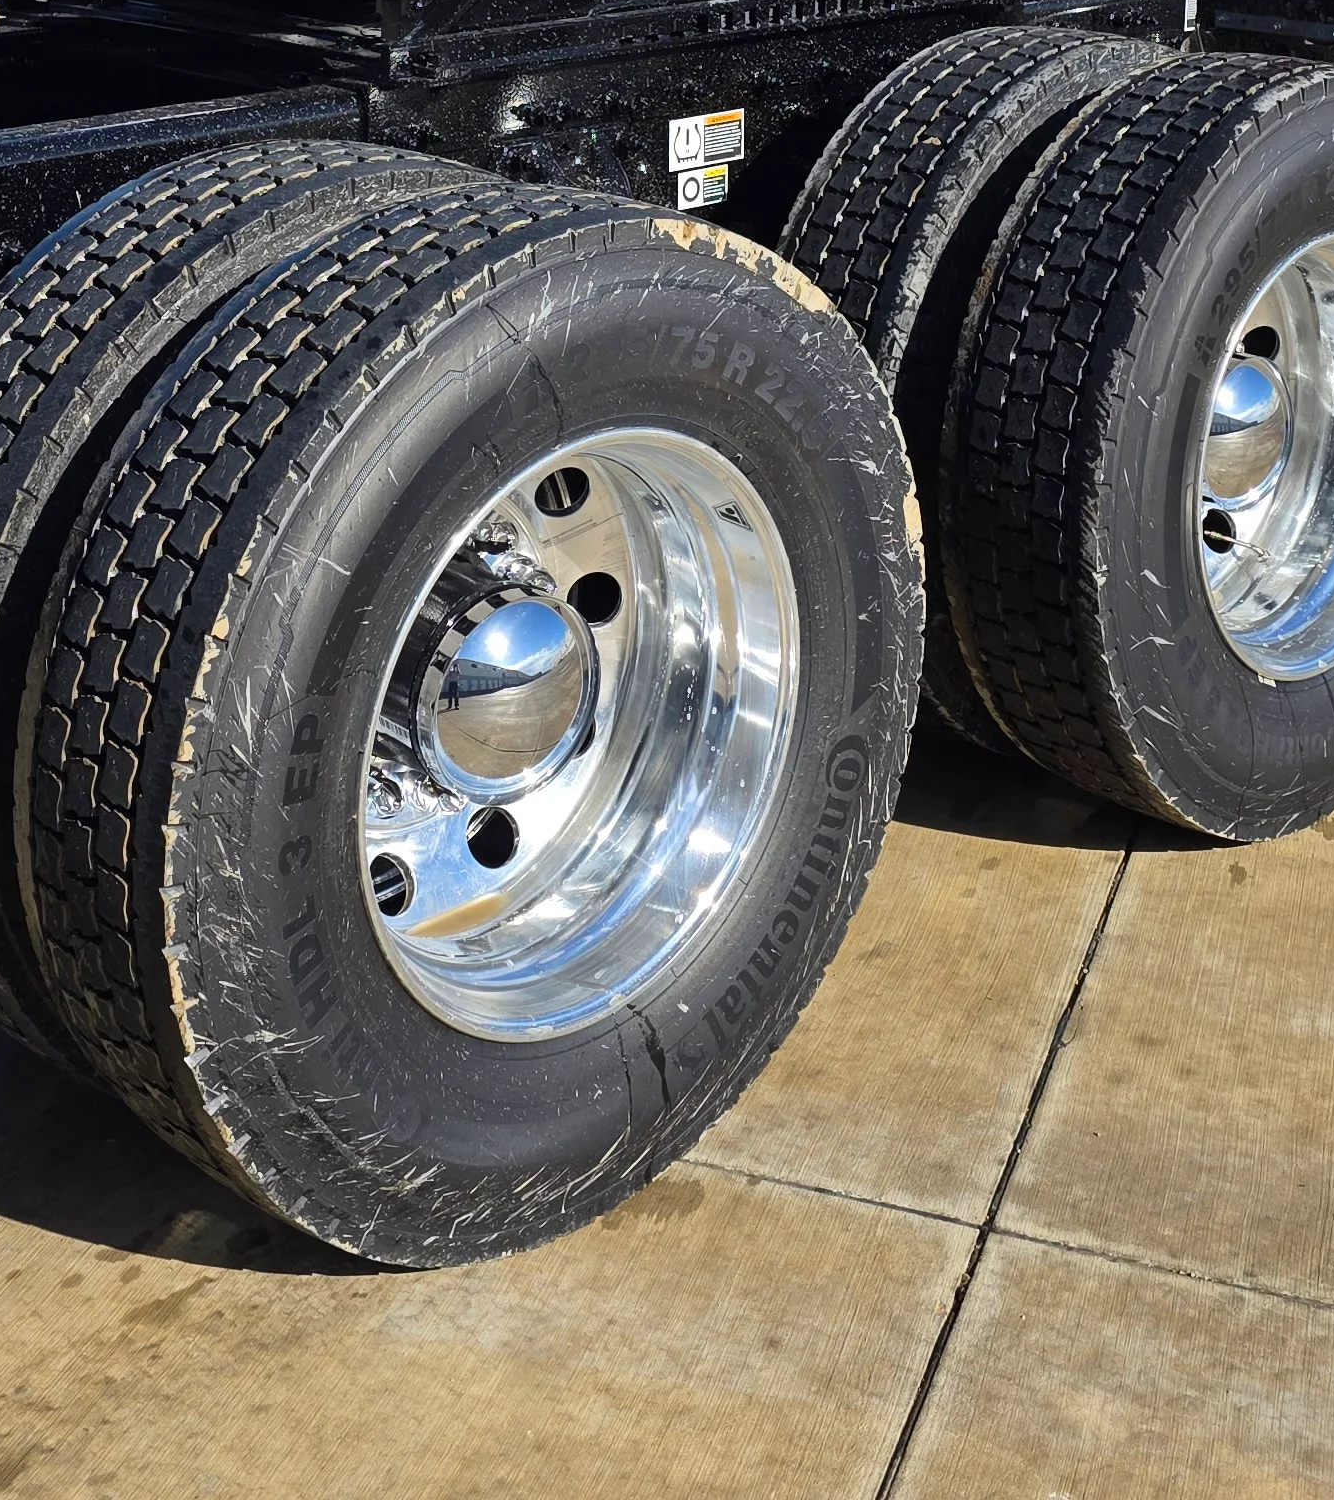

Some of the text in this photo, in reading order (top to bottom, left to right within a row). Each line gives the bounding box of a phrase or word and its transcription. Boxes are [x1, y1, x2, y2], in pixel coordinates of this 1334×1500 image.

[720, 339, 757, 388] R
[283, 711, 326, 808] EP
[277, 831, 313, 878] 3
[701, 733, 869, 1056] Continental
[282, 891, 340, 1030] HDL
